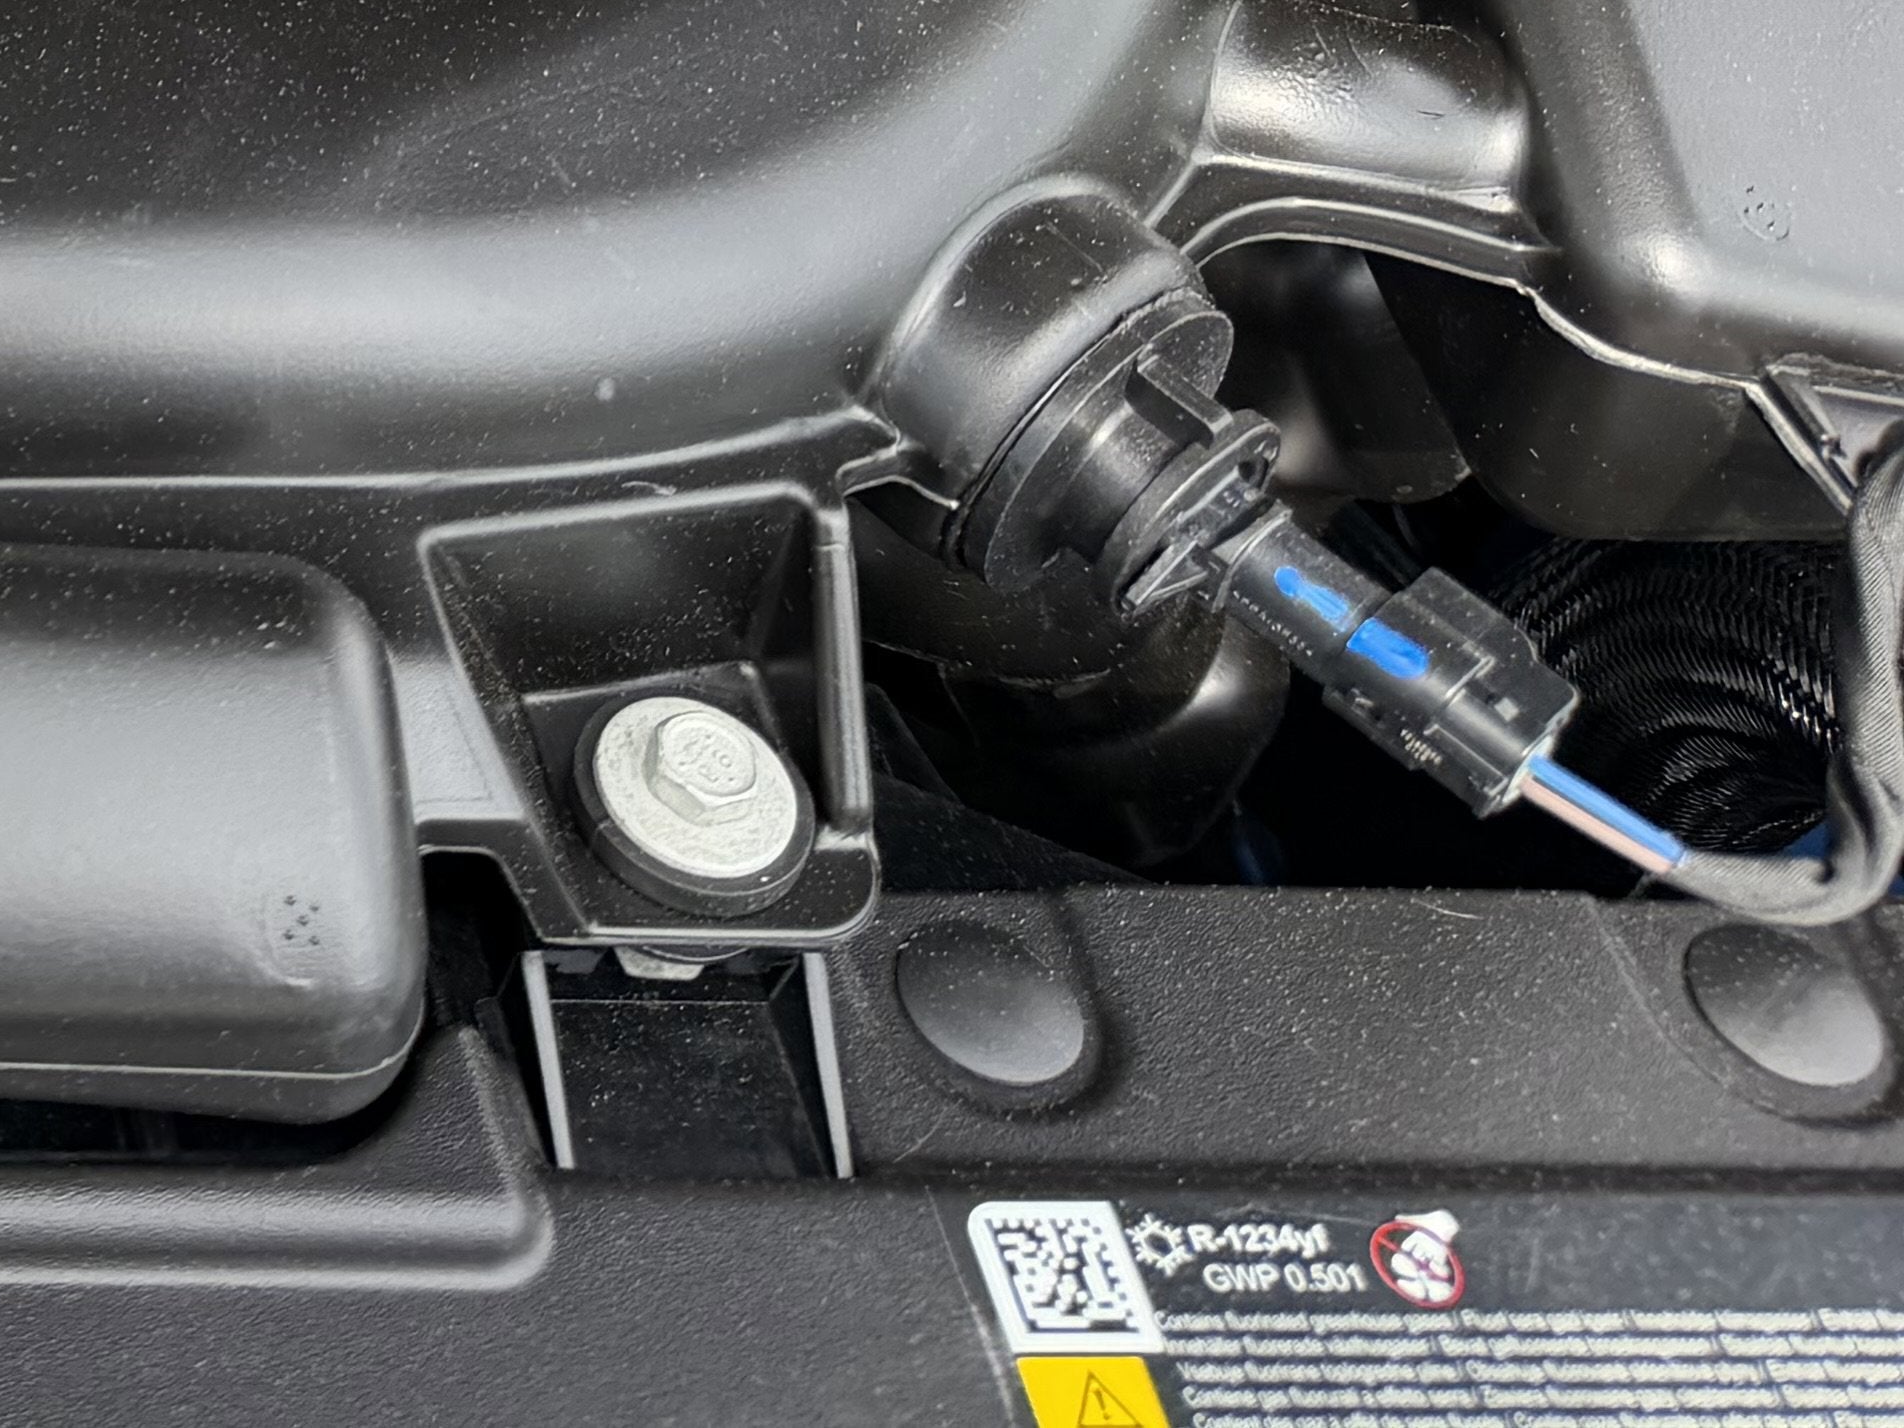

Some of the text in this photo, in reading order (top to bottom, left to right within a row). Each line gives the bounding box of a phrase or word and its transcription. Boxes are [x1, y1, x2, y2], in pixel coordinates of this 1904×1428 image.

[1186, 1223, 1331, 1260] R-1234yf
[1203, 1262, 1369, 1293] GWP 0.501
